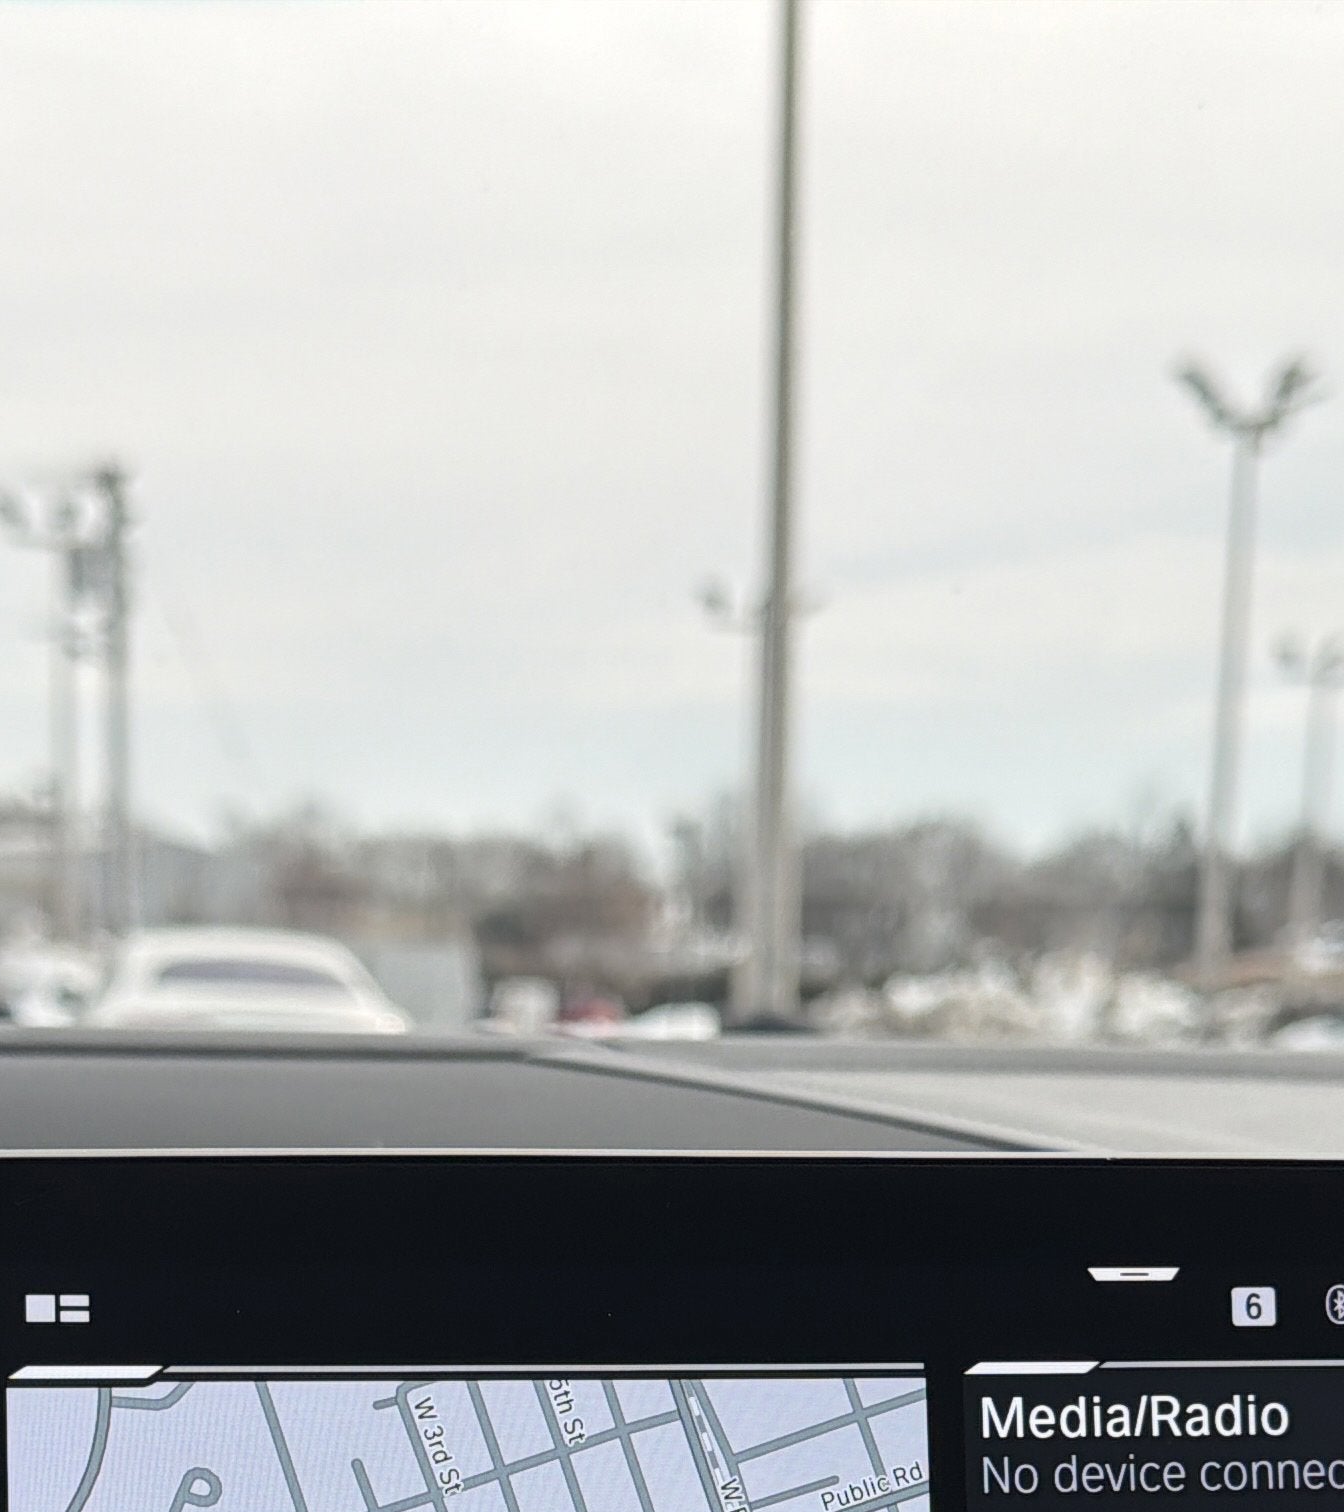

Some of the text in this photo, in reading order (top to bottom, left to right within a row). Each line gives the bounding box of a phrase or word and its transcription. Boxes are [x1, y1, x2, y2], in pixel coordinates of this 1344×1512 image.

[1245, 1292, 1262, 1320] 6
[564, 1418, 585, 1444] St
[981, 1393, 1290, 1439] Media/Radio
[415, 1396, 462, 1494] W 3rd St
[721, 1478, 743, 1500] W
[821, 1461, 924, 1511] Public Rd
[982, 1455, 1038, 1494] No
[1054, 1453, 1186, 1493] device
